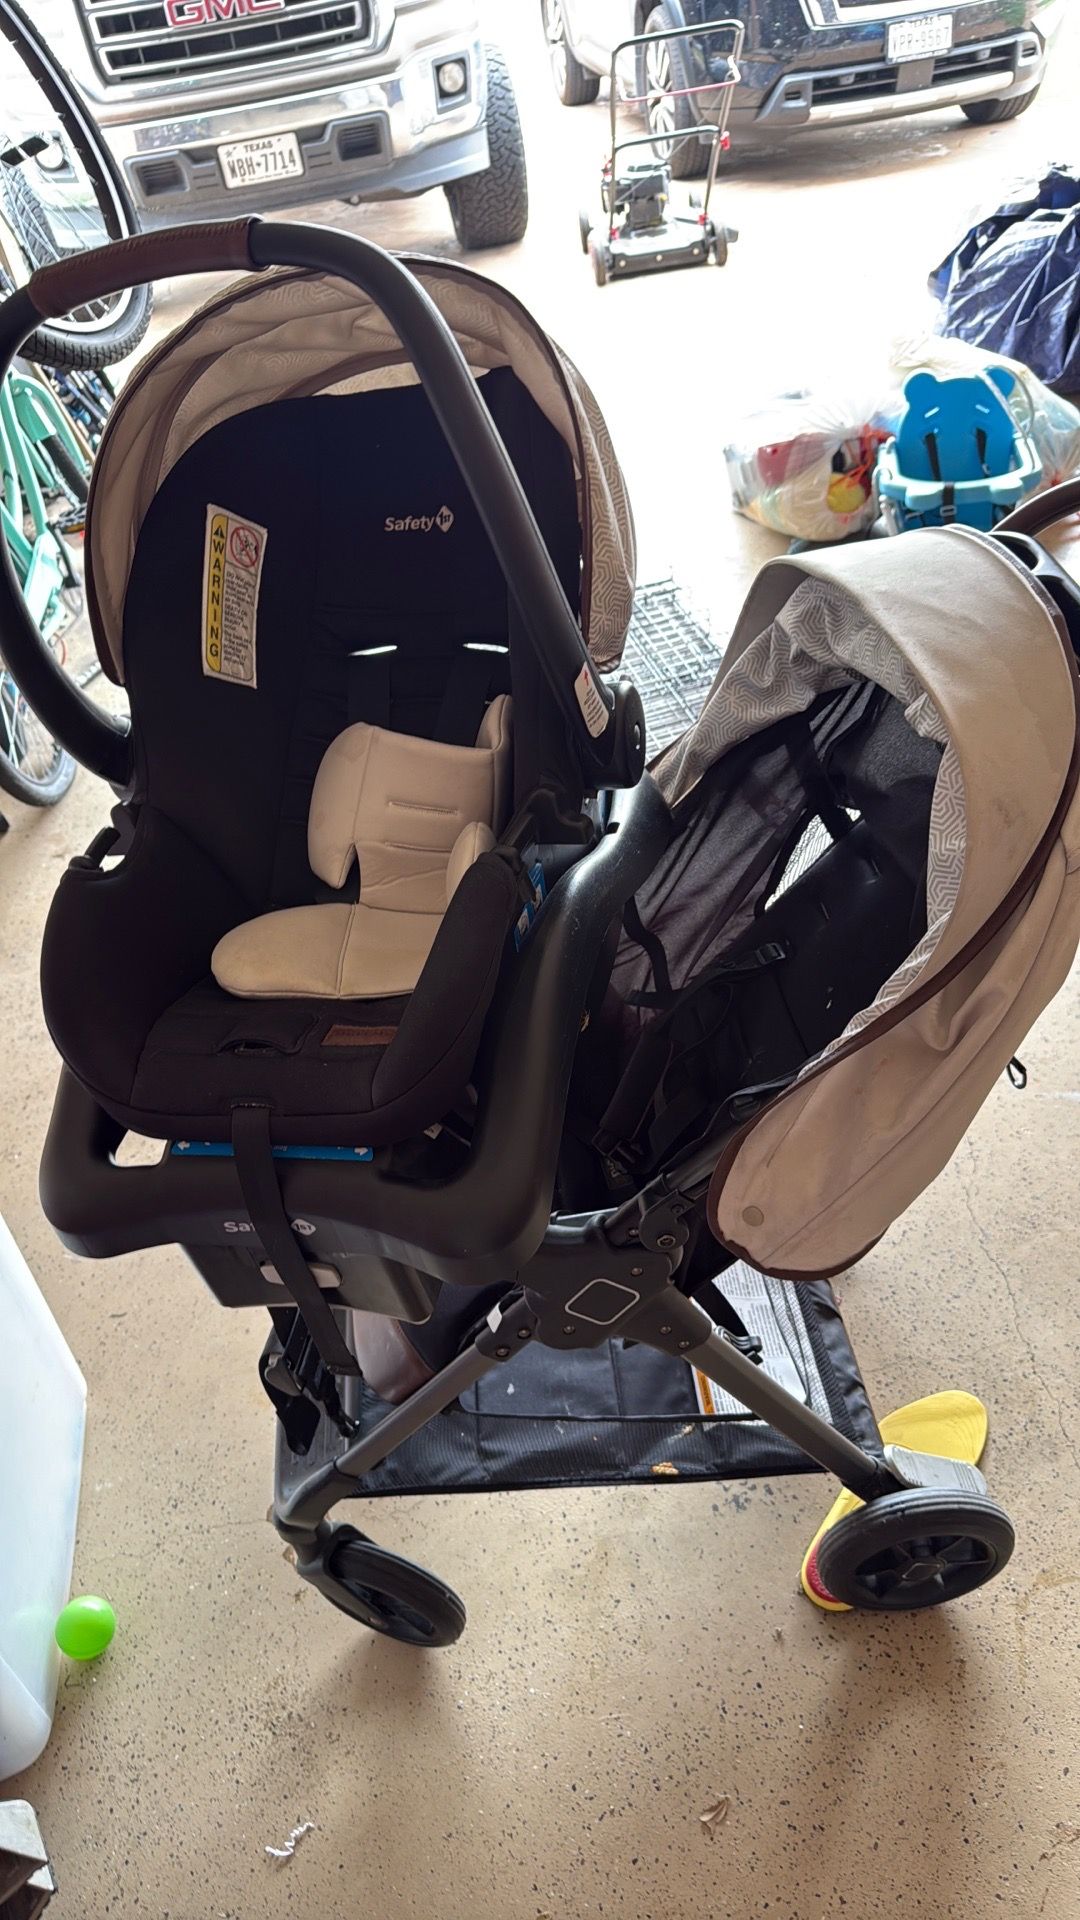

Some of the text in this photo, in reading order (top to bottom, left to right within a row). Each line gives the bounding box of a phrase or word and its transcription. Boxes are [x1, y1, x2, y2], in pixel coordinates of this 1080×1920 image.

[243, 140, 273, 153] TEXAS
[384, 515, 435, 532] Safety
[209, 539, 224, 657] WARNING
